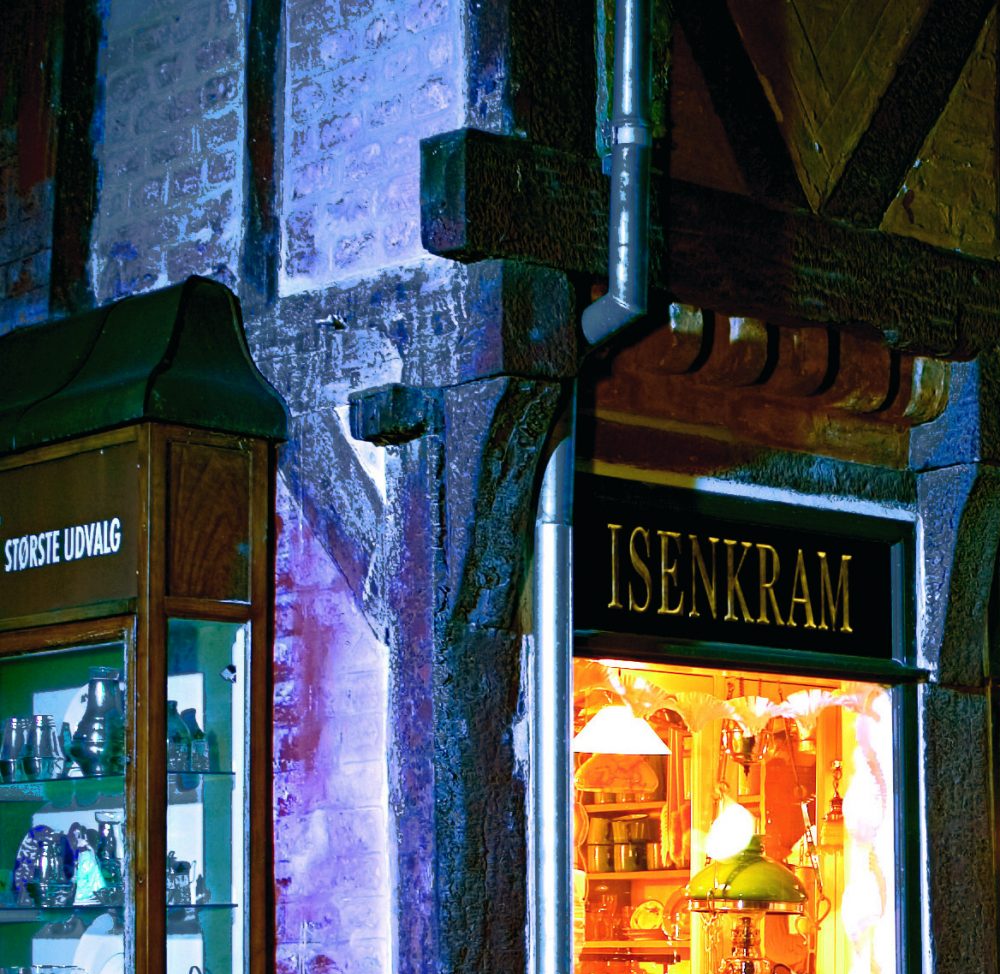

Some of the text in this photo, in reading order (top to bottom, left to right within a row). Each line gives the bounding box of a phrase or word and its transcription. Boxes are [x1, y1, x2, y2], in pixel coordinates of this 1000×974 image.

[4, 518, 121, 572] STØRSTE UDVALG
[607, 523, 853, 632] ISENKRAM
